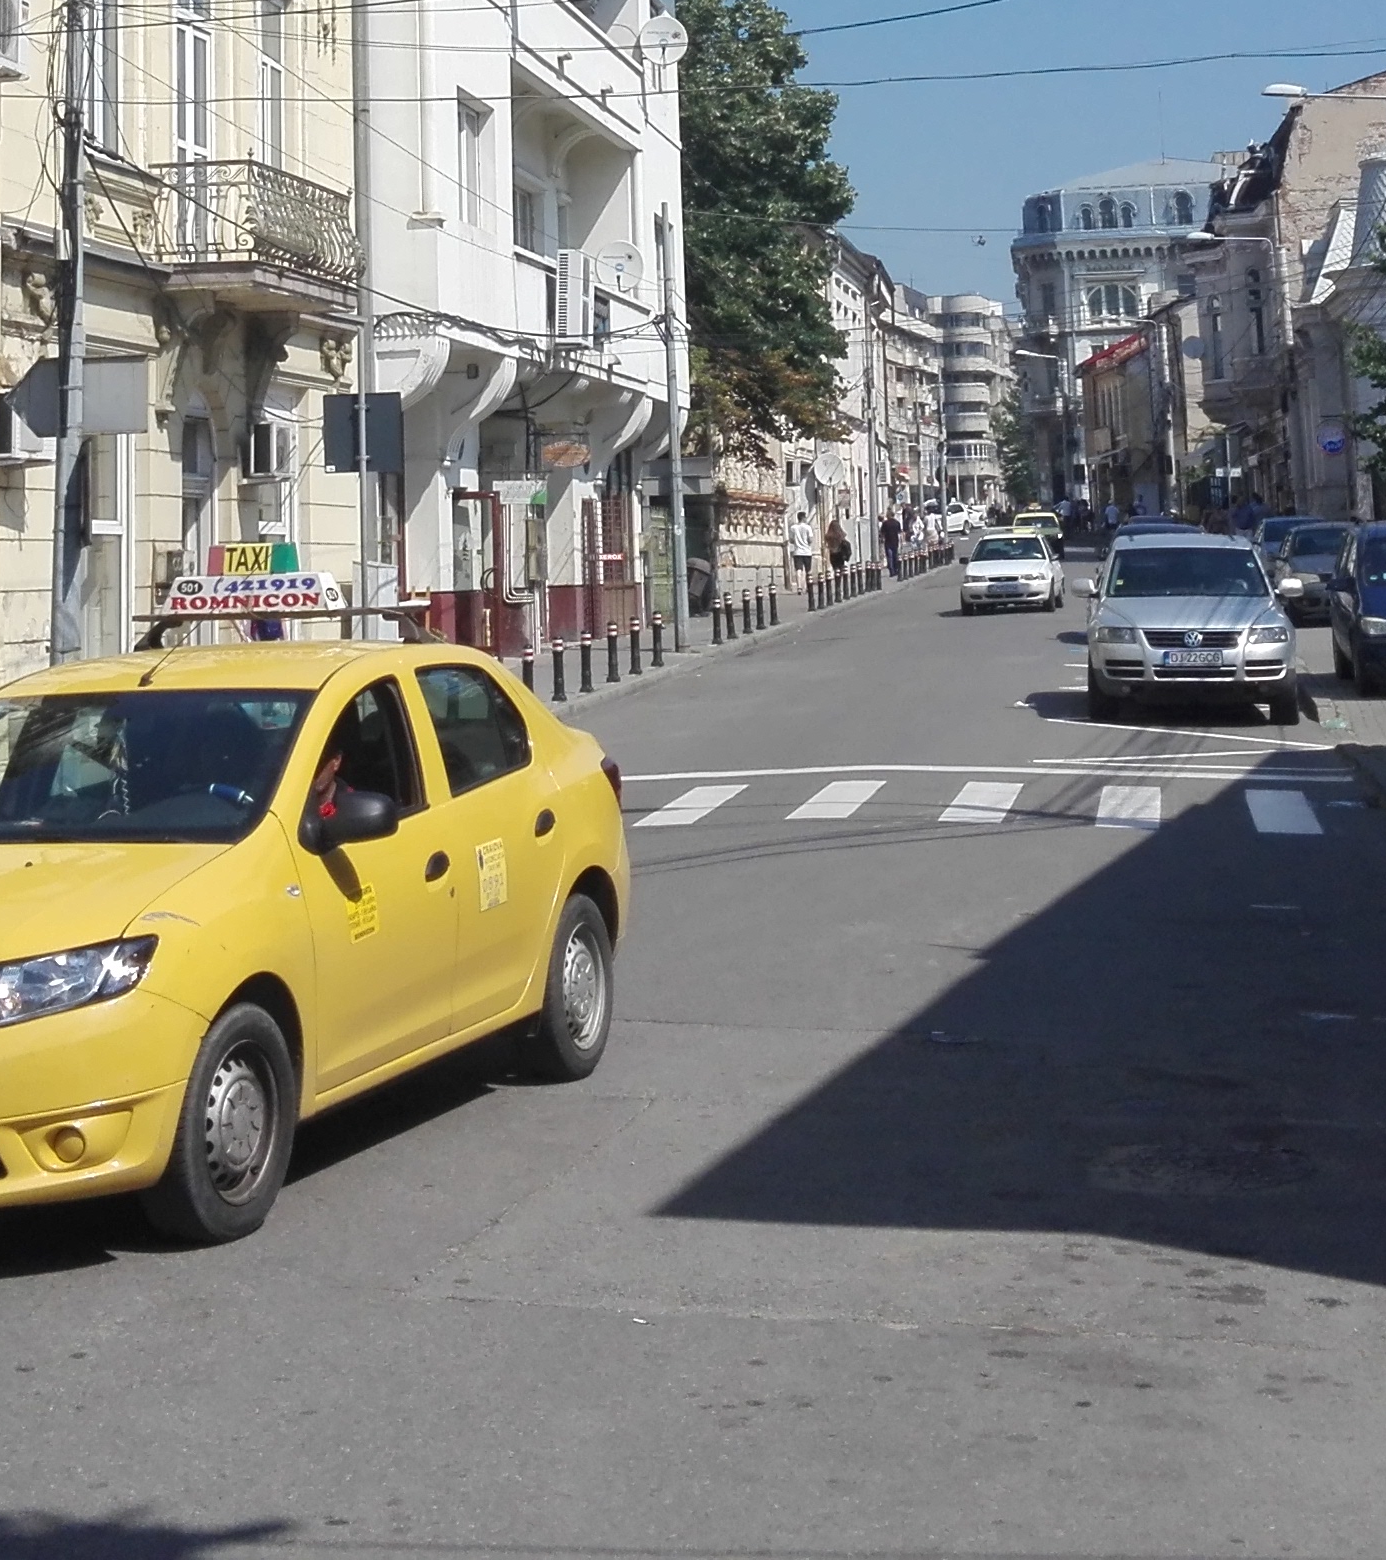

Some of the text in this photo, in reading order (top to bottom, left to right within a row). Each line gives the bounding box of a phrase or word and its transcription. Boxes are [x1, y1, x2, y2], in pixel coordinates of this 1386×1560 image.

[226, 545, 269, 573] TAXI
[598, 553, 623, 561] XEROX
[181, 581, 200, 594] 501
[170, 592, 321, 610] ROMNICON
